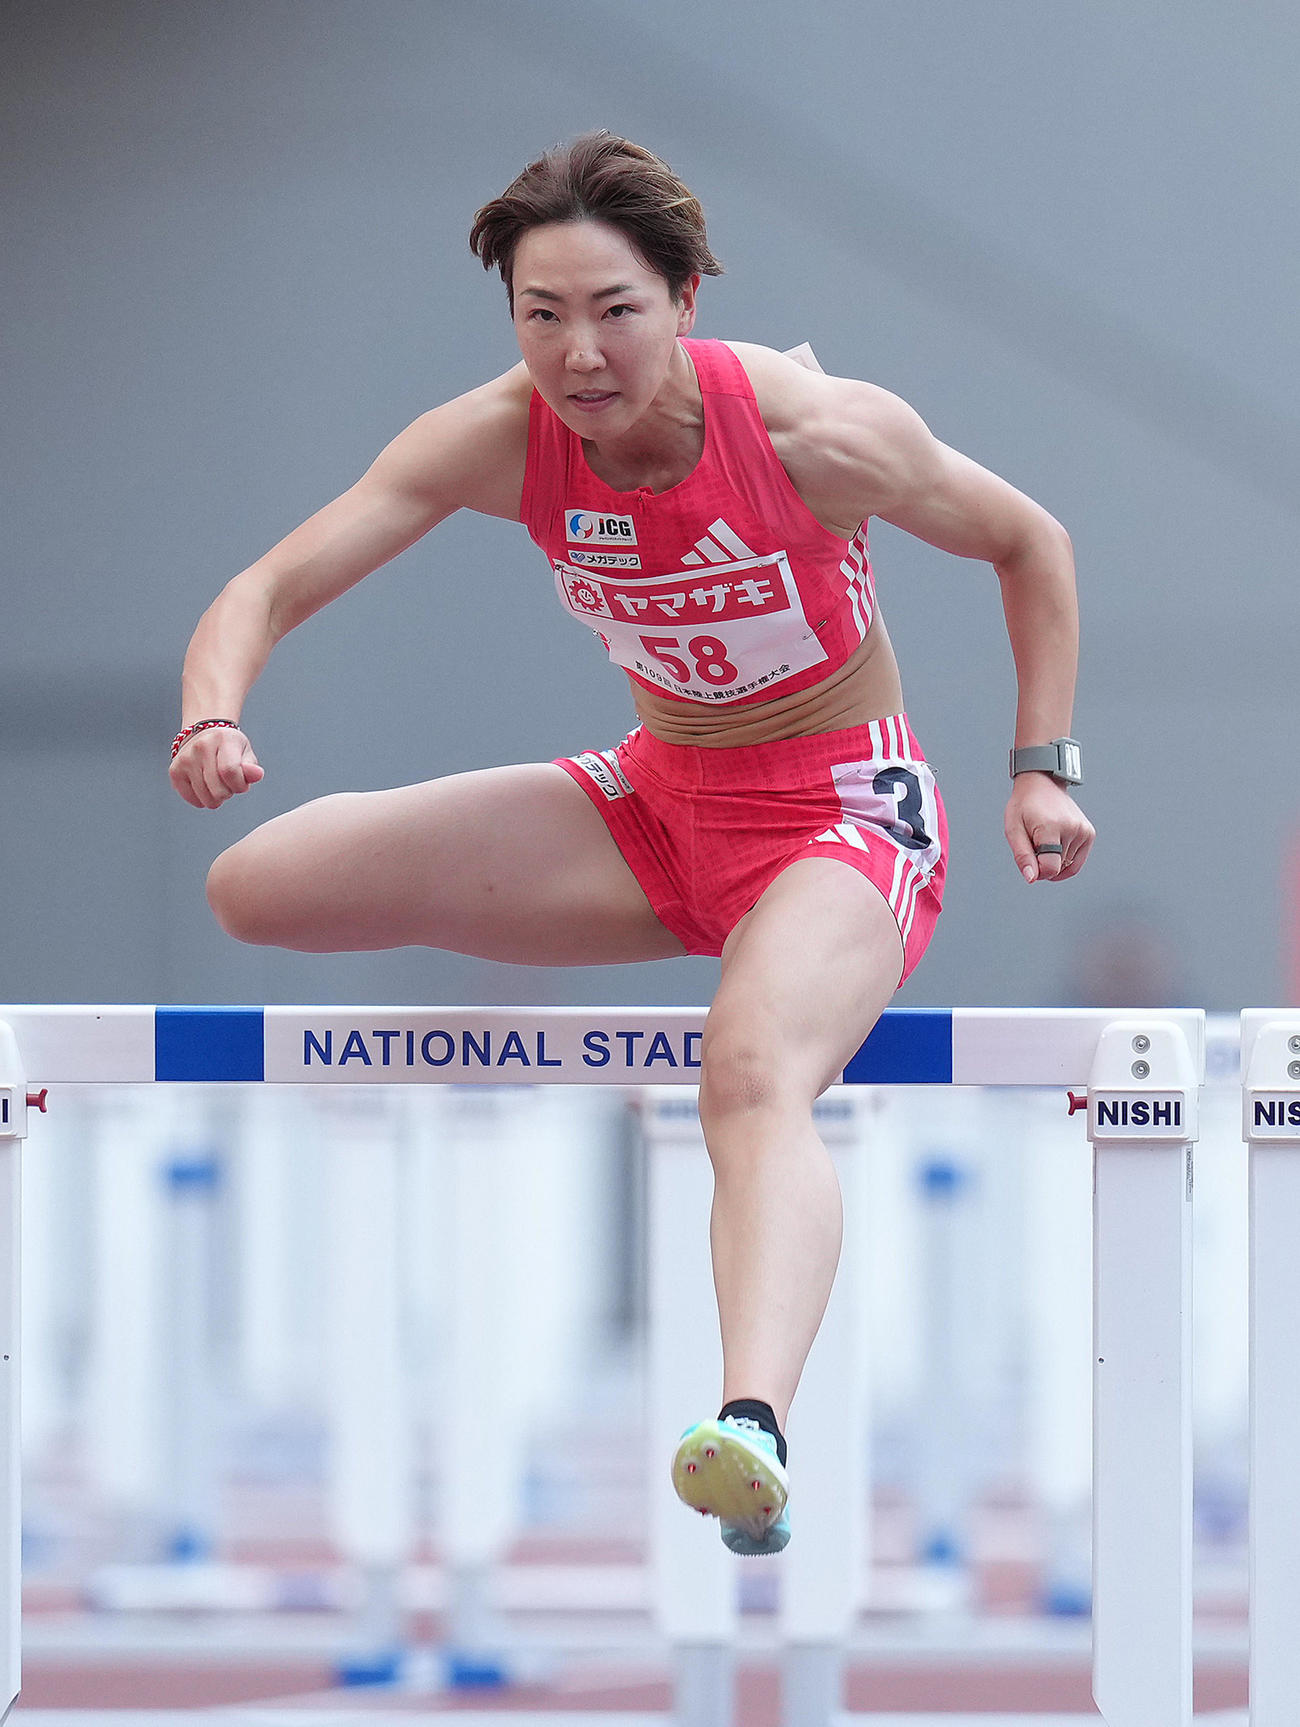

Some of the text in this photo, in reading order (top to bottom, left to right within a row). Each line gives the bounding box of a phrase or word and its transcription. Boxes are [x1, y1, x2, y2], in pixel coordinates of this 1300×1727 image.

[599, 518, 632, 537] JCG
[587, 554, 639, 566] メガテック
[614, 578, 775, 617] ヤマザキ
[638, 635, 738, 686] 58
[872, 766, 932, 851] 3
[303, 1030, 562, 1067] NATIONAL
[1097, 1100, 1181, 1126] NISHI
